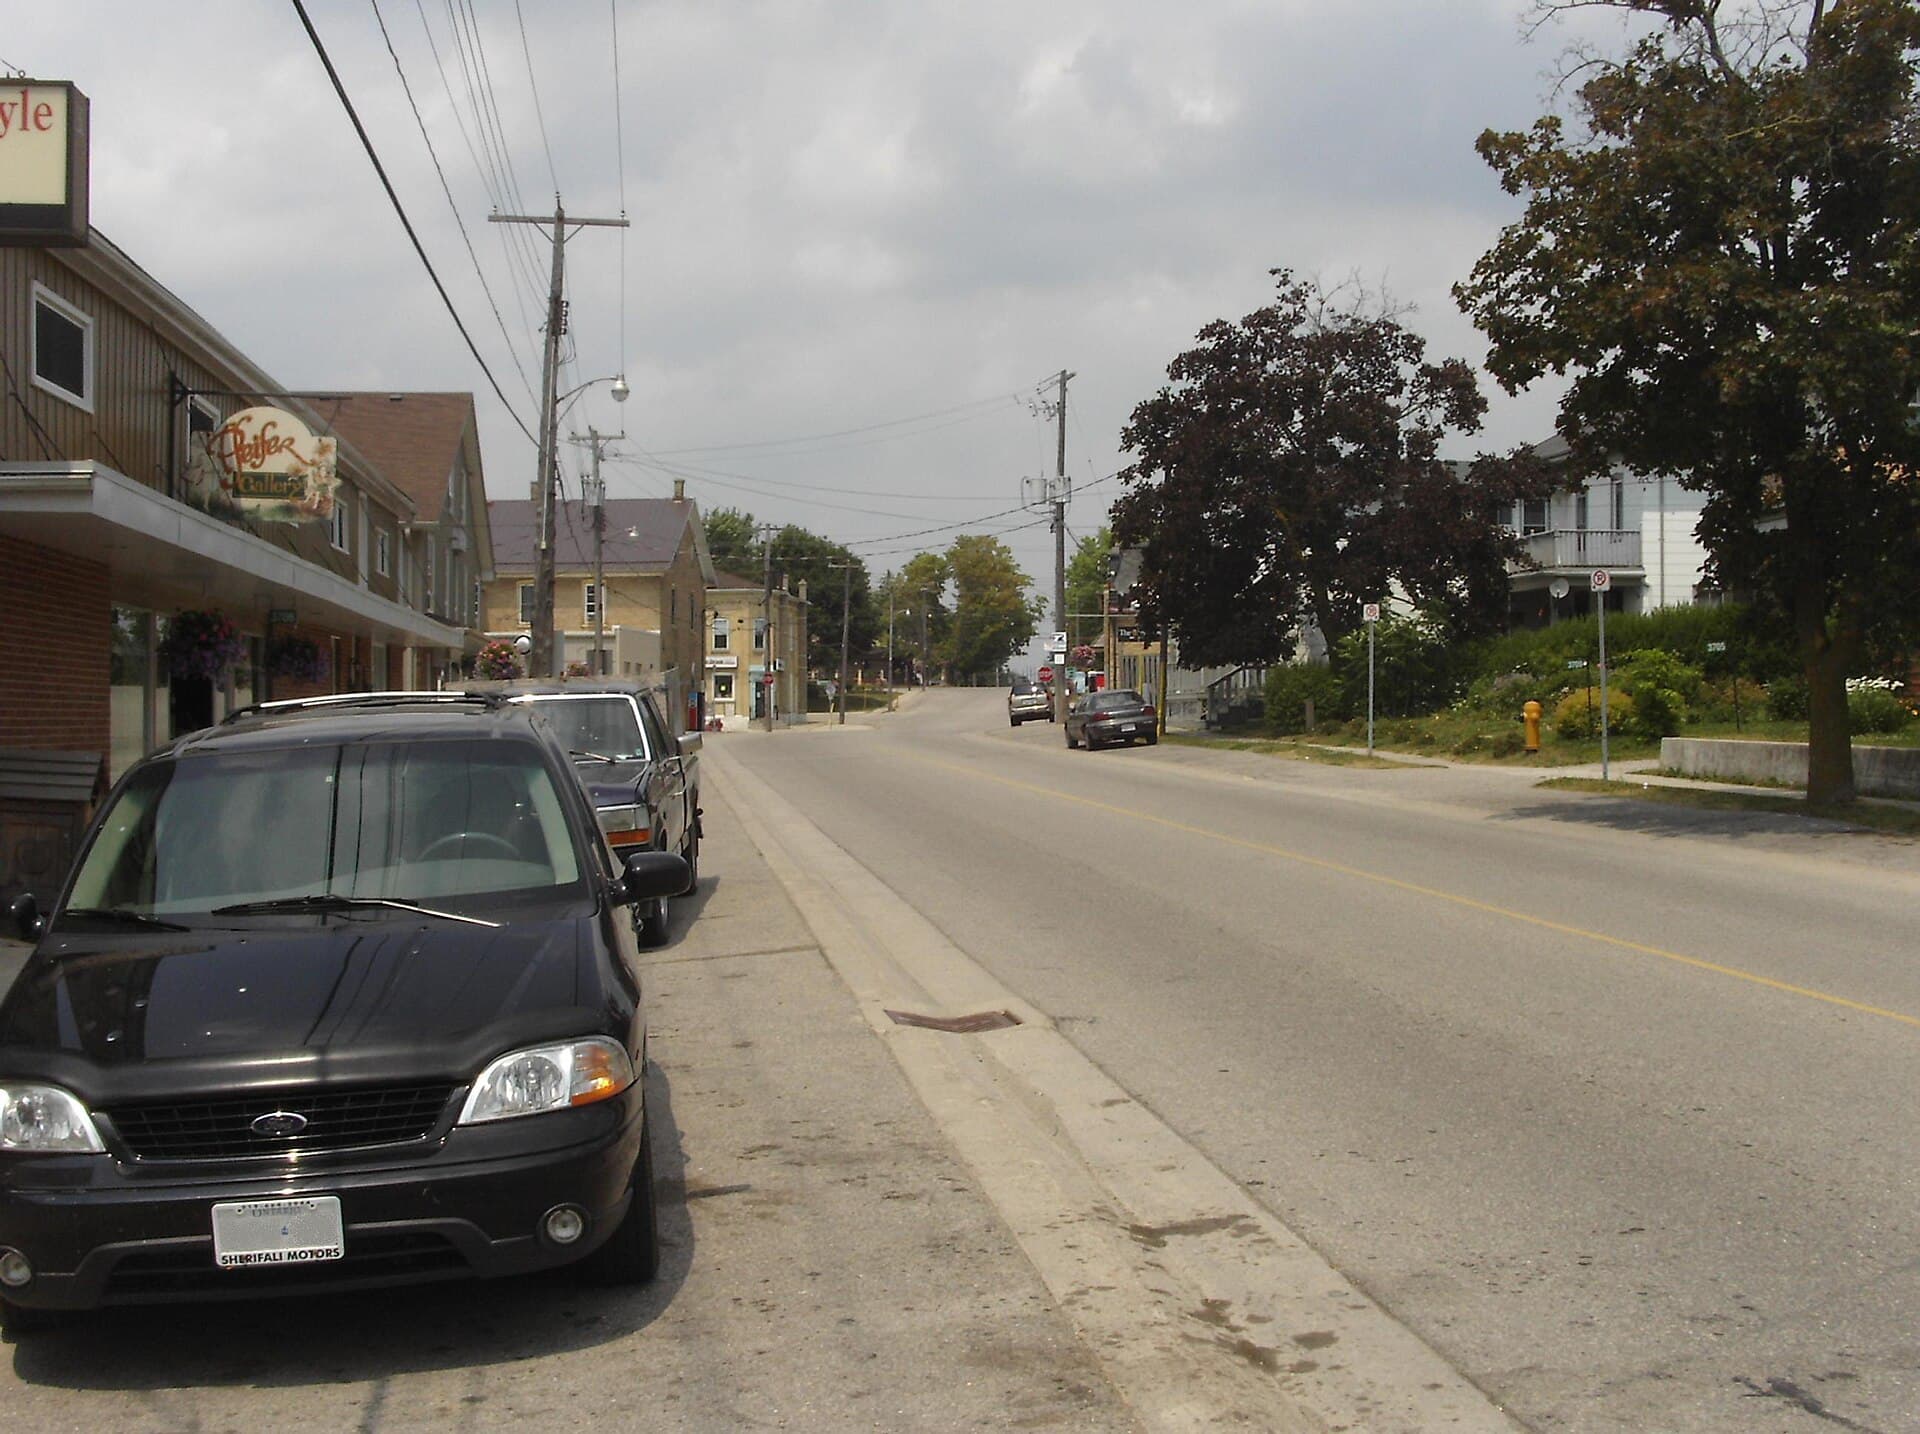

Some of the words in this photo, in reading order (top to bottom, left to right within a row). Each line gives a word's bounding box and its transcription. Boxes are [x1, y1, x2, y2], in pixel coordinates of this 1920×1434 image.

[0, 89, 53, 138] yle
[240, 472, 303, 497] Gallery
[221, 1251, 283, 1265] SHERIFALI
[287, 1248, 340, 1261] MOTORS
